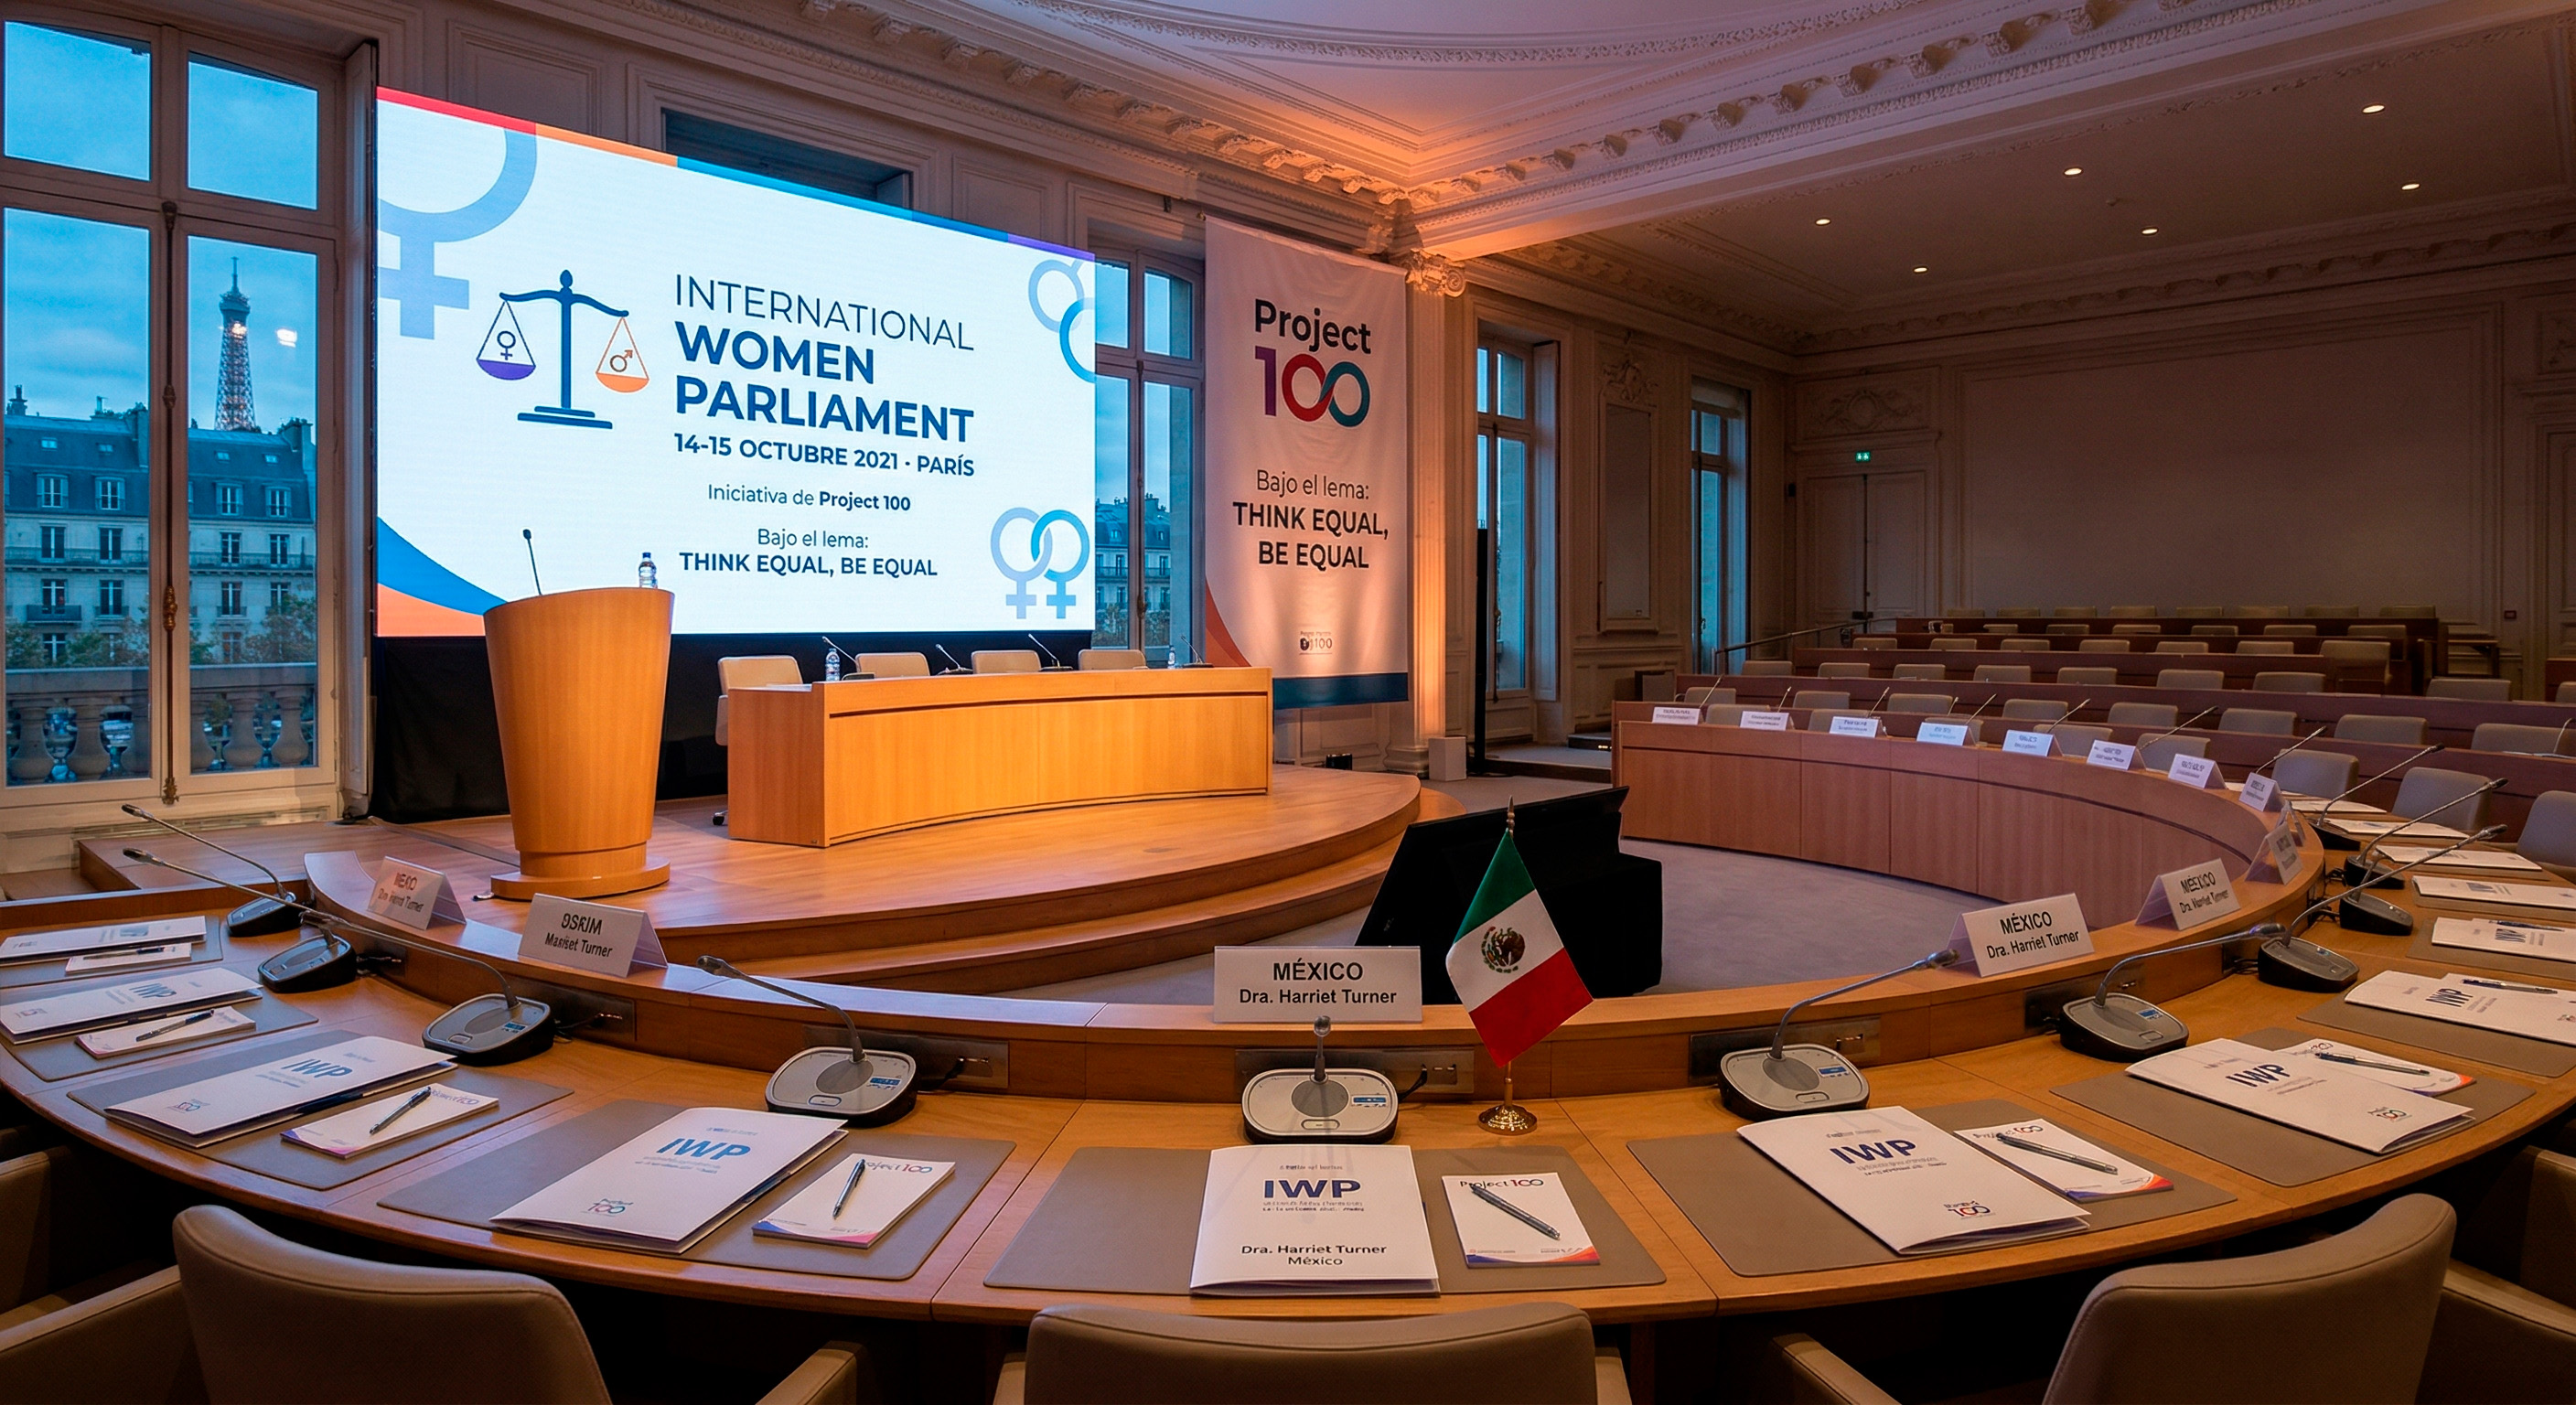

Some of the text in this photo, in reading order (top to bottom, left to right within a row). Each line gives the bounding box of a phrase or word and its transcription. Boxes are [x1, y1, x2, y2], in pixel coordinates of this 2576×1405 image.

[675, 273, 974, 351] INTERNATIONAL
[1254, 298, 1371, 355] Project
[674, 320, 875, 385] WOMEN
[1254, 345, 1371, 428] 100
[676, 374, 975, 443] PARLIAMENT
[674, 432, 733, 456] 14-15
[739, 438, 848, 467] OCTUBRE
[853, 448, 898, 470] 2021
[917, 453, 975, 477] PARÍS
[707, 483, 911, 511] Iniciativa de Project 100
[1256, 468, 1370, 500] Bajo el lema:
[1232, 501, 1390, 541] THINK EQUAL,
[757, 528, 869, 550] Bajo el lema:
[679, 552, 939, 579] THINK EQUAL, BE EQUAL
[1258, 540, 1370, 572] BE EQUAL
[2000, 911, 2053, 935] MÉXICO
[581, 938, 614, 958] Turner
[1986, 944, 2010, 960] Dra.
[2046, 930, 2079, 947] Turner
[1272, 958, 1364, 981] MÉXICO
[1239, 988, 1398, 1004] Dra. Harriet Turner
[280, 1058, 353, 1078] IWP
[2225, 1063, 2291, 1088] IWP
[655, 1137, 751, 1161] IWP
[1829, 1139, 1916, 1164] IWP
[1264, 1179, 1361, 1198] IWP
[1241, 1244, 1388, 1254] Dra. Harriet Turner
[1288, 1256, 1343, 1266] México
